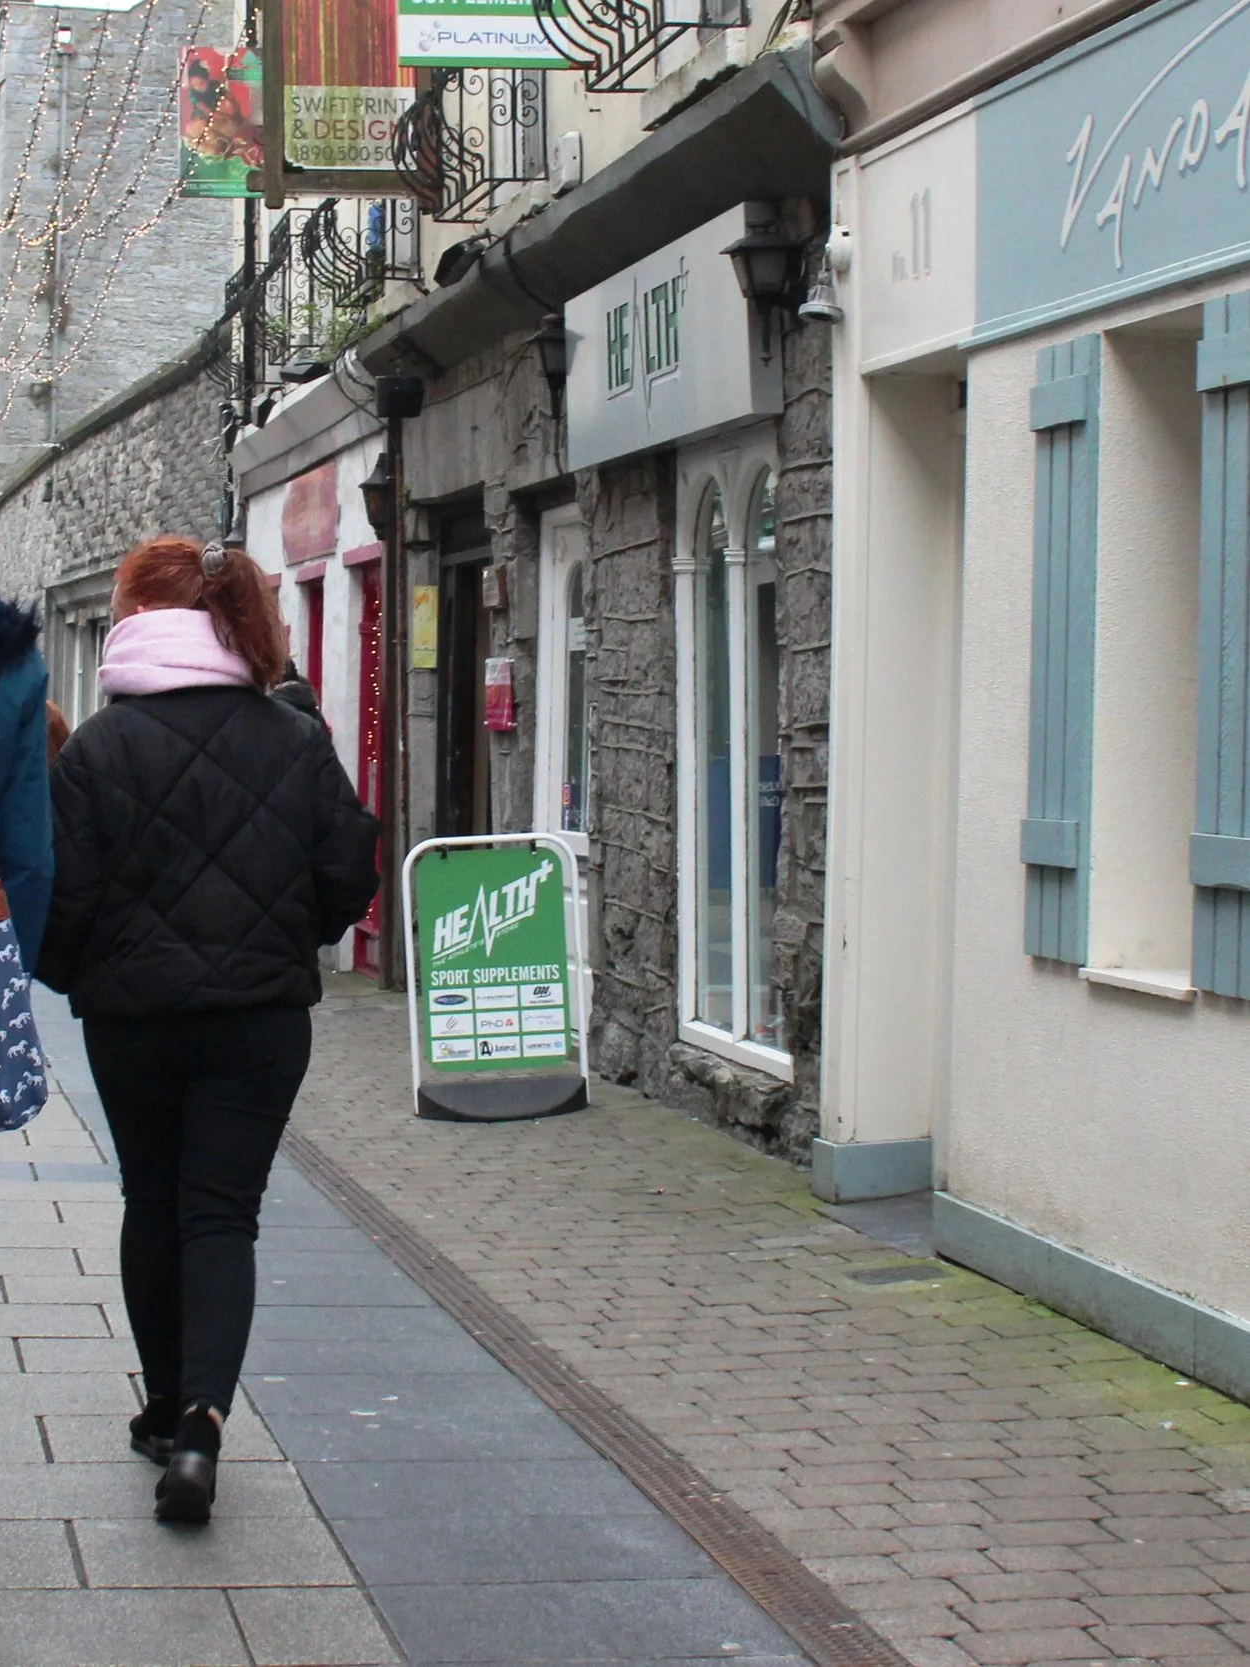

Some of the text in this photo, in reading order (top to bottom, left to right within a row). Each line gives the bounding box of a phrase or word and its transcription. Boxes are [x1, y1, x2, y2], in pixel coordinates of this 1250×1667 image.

[437, 31, 550, 45] PLATINUM
[292, 97, 408, 115] SWIFT PRINT
[292, 119, 308, 140] &
[431, 964, 560, 986] SPORT SUPPLEMENTS
